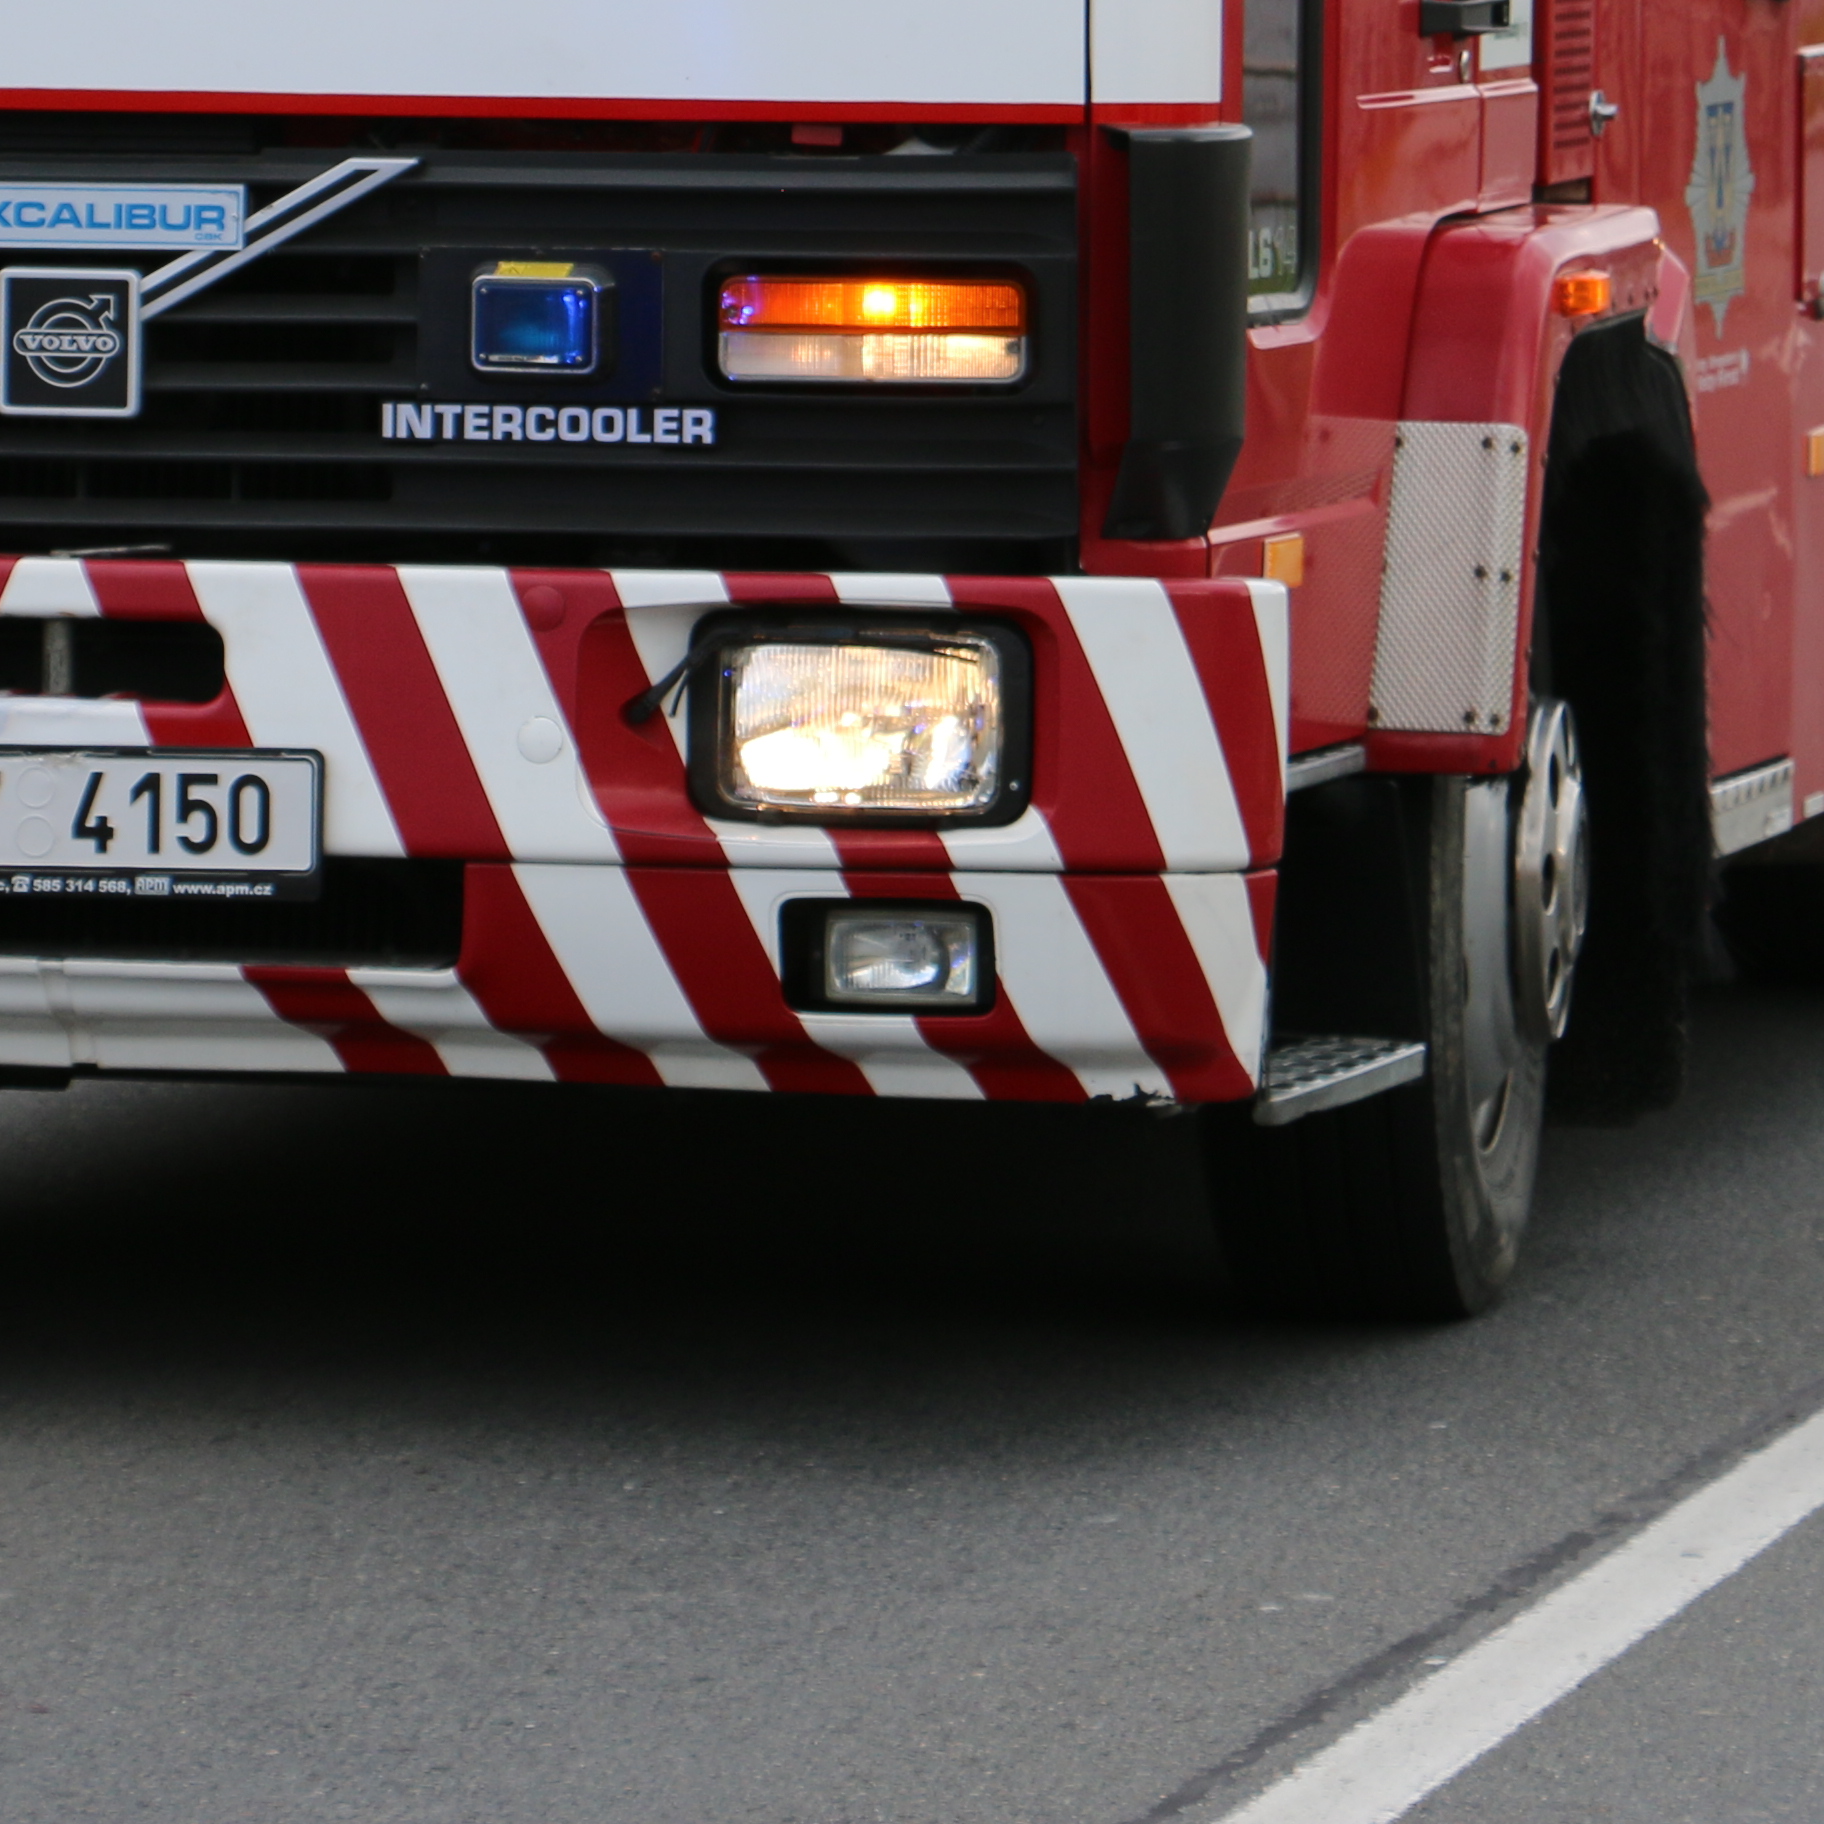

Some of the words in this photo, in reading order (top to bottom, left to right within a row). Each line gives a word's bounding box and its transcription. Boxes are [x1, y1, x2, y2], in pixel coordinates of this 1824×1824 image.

[19, 334, 114, 352] VOLVO
[382, 403, 714, 444] INTERCOOLER
[70, 772, 270, 855] 4150
[33, 879, 61, 892] 585
[66, 879, 93, 892] 314
[98, 880, 131, 895] 568,
[173, 884, 273, 897] www.apm.cz
